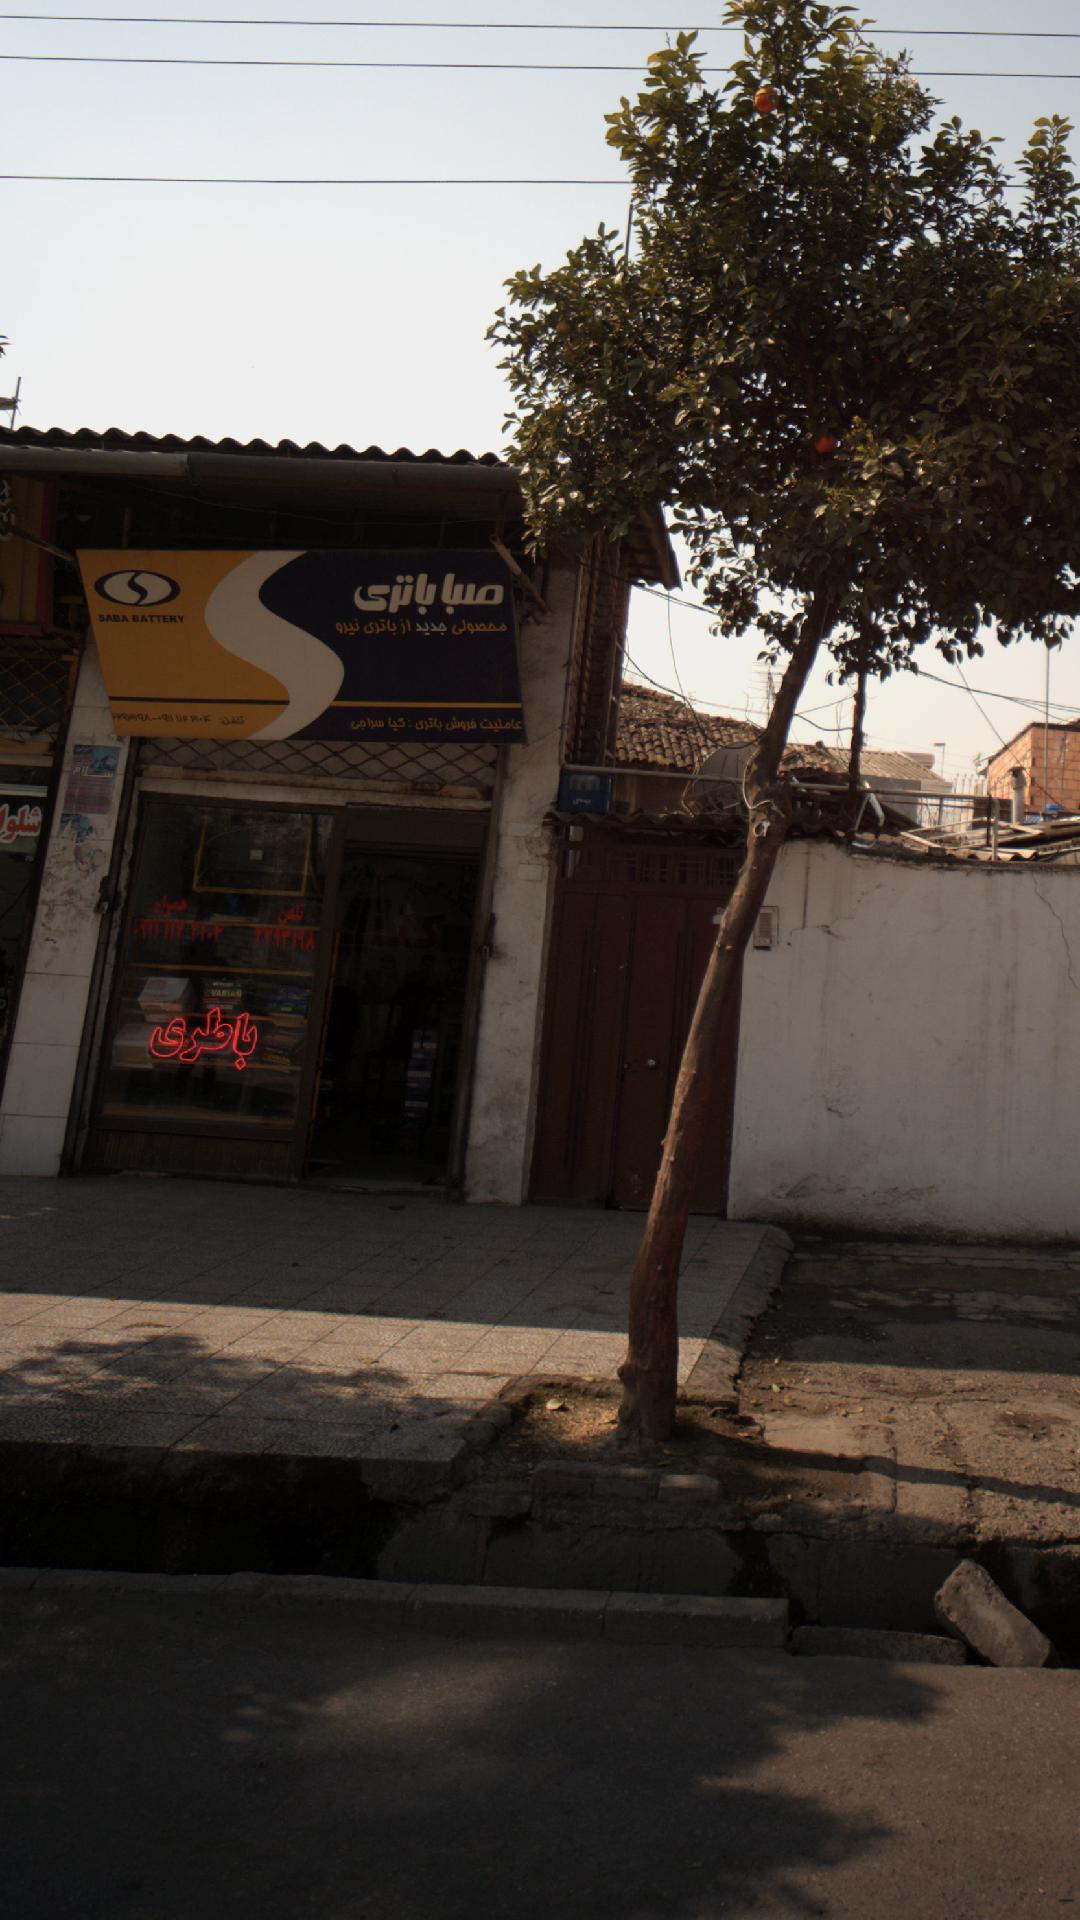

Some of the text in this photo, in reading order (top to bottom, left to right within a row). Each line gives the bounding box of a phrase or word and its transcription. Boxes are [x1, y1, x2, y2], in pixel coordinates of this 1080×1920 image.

[353, 573, 505, 615] صبا باتری
[98, 614, 185, 625] SABA BATTERY
[363, 617, 398, 636] باتری
[400, 619, 411, 635] از
[452, 619, 509, 636] محصولی
[415, 621, 448, 636] جدید
[415, 716, 443, 732] باتری
[446, 716, 477, 731] فروش
[150, 1007, 259, 1072] باطری
